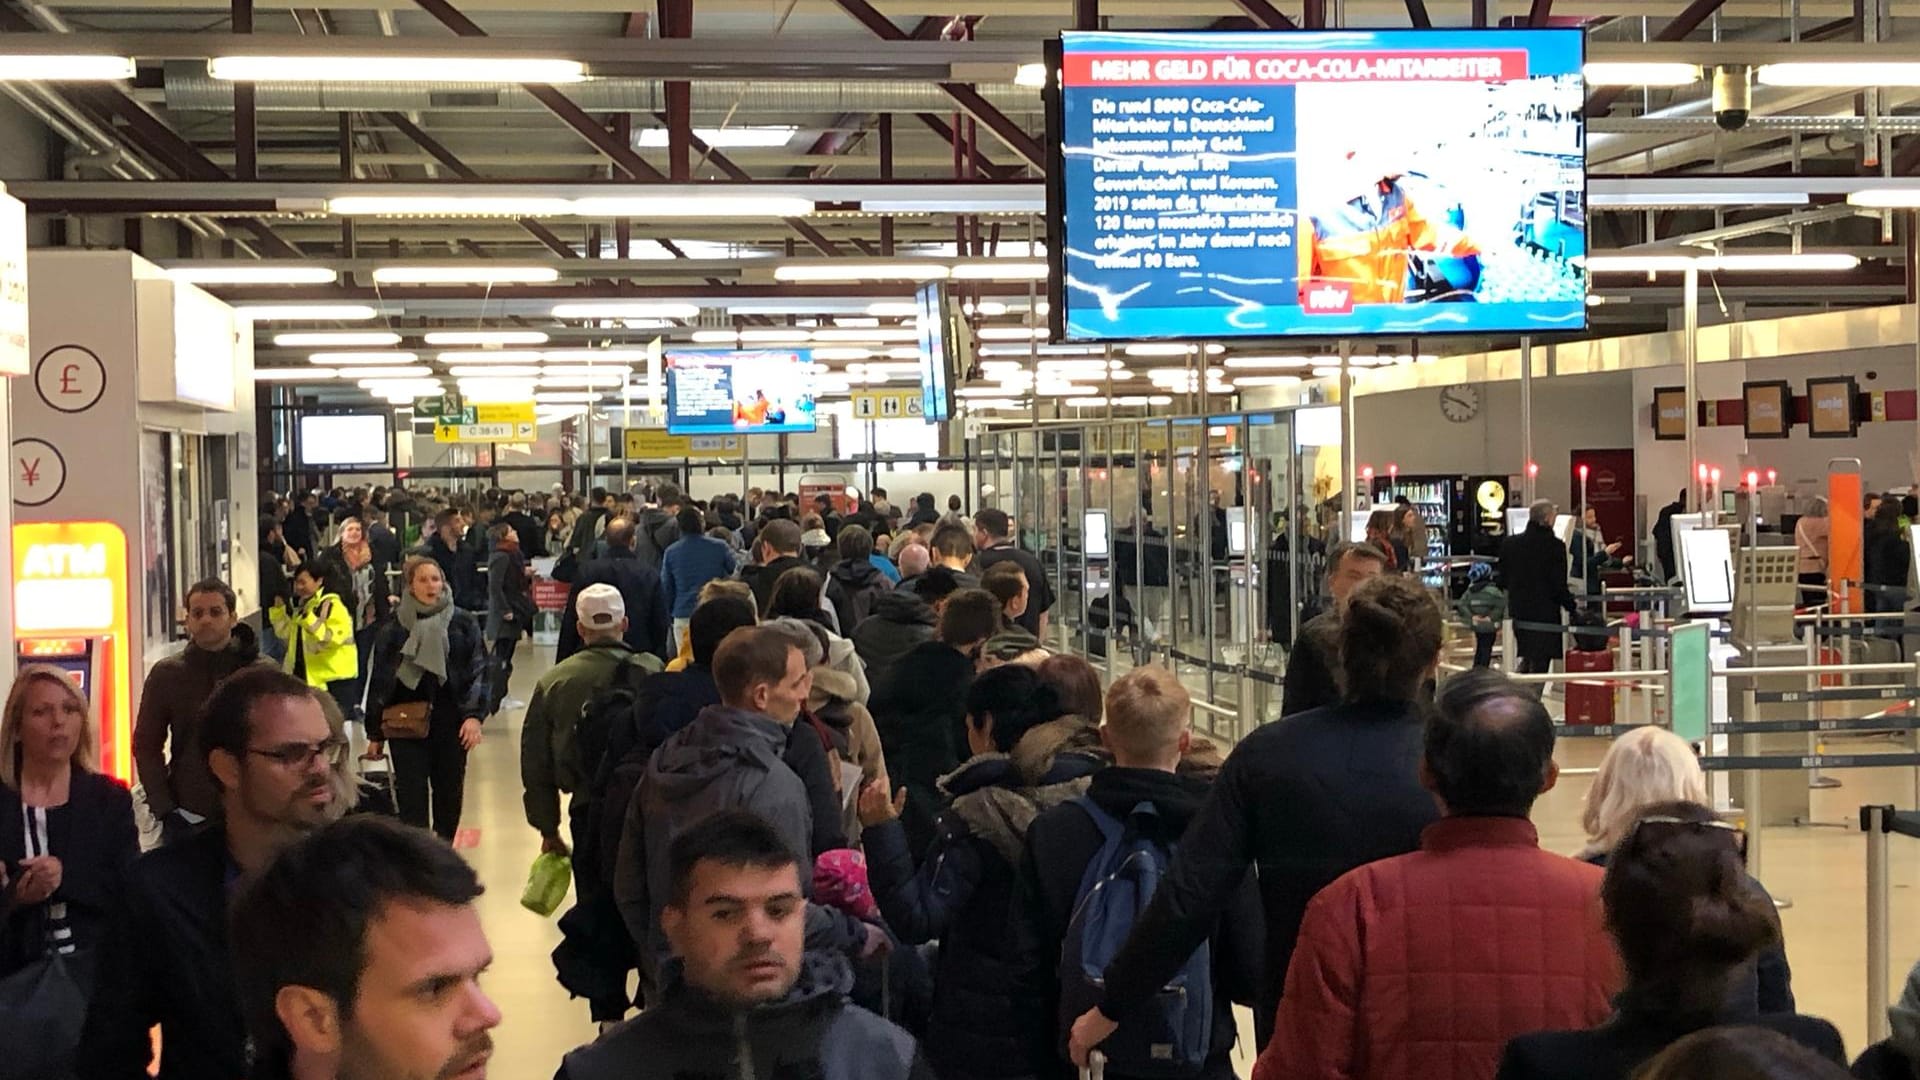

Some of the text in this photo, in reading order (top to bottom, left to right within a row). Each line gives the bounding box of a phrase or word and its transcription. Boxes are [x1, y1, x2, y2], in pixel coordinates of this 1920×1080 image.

[1091, 55, 1502, 80] MEHR GELD FÜR COCA-COLA-MITARBEITER
[1092, 98, 1117, 114] Die
[1119, 97, 1151, 114] rund
[1191, 97, 1265, 114] Coca-Cola-
[1092, 116, 1274, 134] Mitarbeiter in Deutschland
[1171, 135, 1208, 153] mehr
[1093, 175, 1188, 192] Gewerkschaft
[1190, 174, 1218, 191] und
[1093, 195, 1129, 212] 2019
[1131, 195, 1173, 211] sollen
[1094, 214, 1121, 231] 120
[1123, 214, 1155, 230] Euro
[1158, 232, 1177, 249] im
[1179, 232, 1208, 249] Jahr
[1257, 231, 1292, 248] noch
[1144, 253, 1162, 269] 90
[1164, 252, 1200, 269] Euro.
[24, 543, 106, 574] ATM
